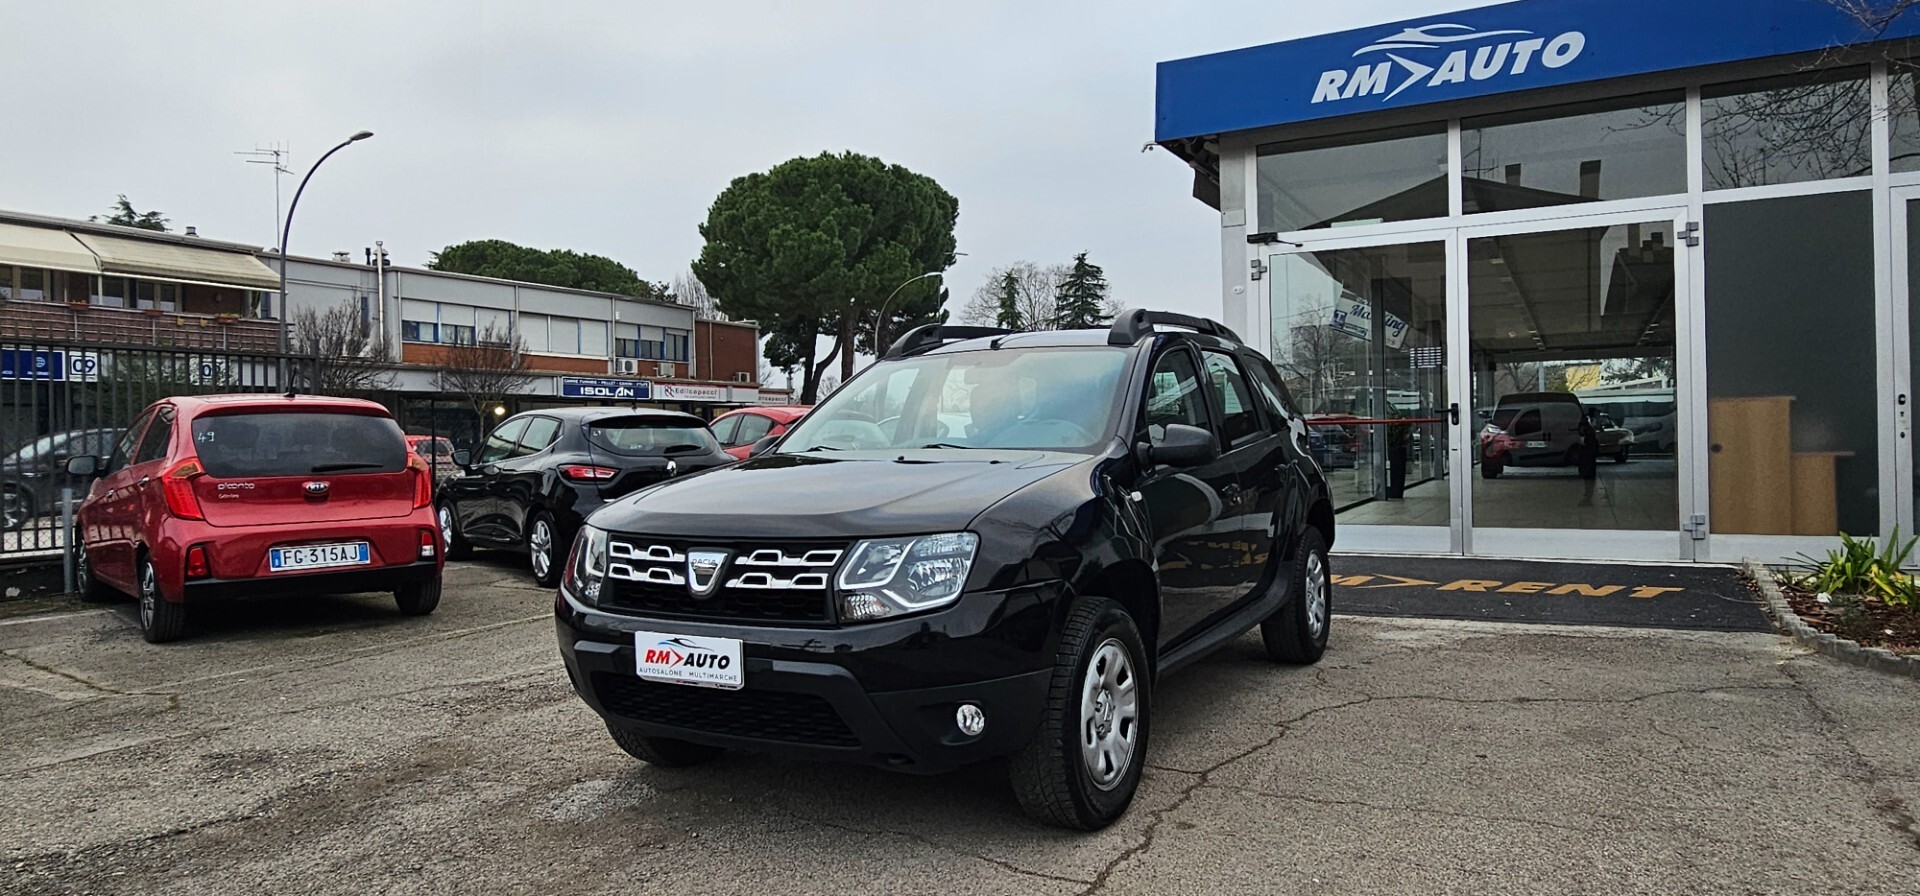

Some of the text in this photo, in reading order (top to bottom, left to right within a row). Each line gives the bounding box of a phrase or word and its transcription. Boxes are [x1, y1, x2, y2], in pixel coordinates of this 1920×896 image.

[1311, 31, 1586, 104] RM AUTO
[73, 359, 96, 373] 09
[580, 387, 634, 398] ISOLAN
[198, 432, 215, 442] 49
[283, 549, 303, 565] FG
[309, 546, 358, 563] 315AJ
[1435, 579, 1686, 598] RENT
[645, 649, 730, 669] RM AUTO
[639, 667, 737, 681] AUTOSALONE MULTIMARCHE
